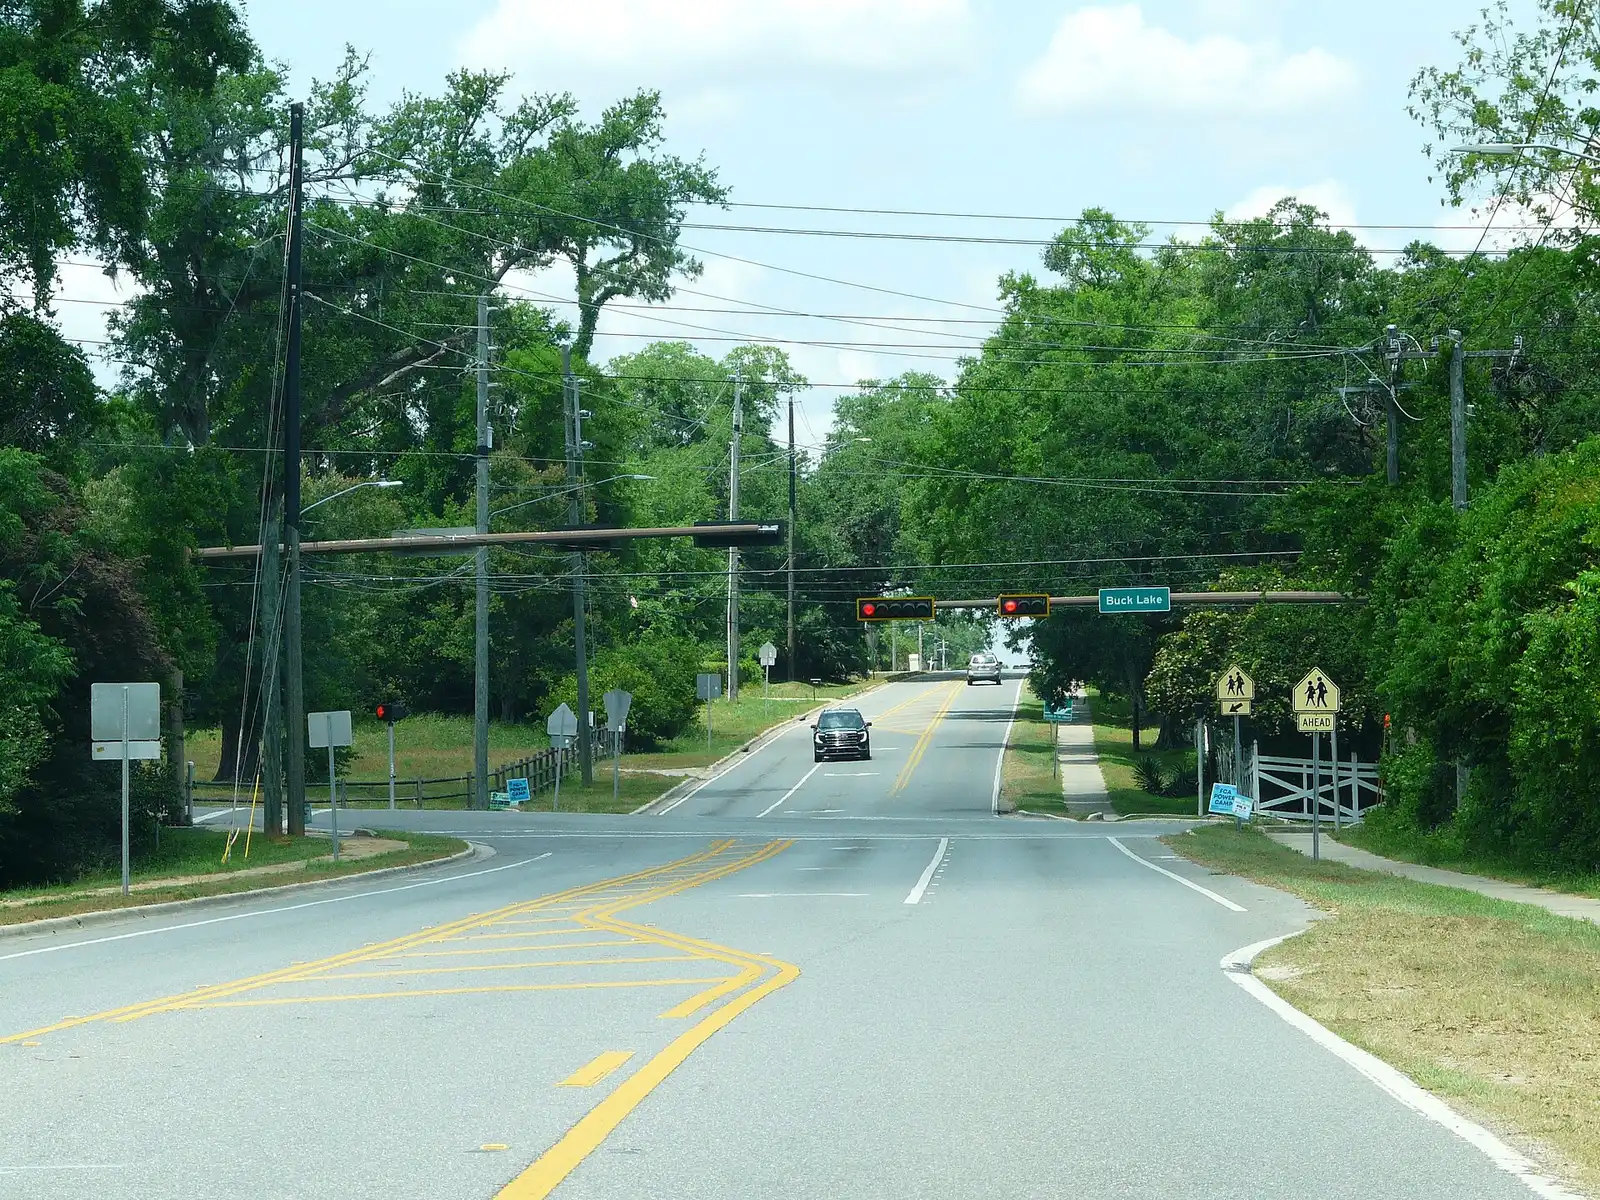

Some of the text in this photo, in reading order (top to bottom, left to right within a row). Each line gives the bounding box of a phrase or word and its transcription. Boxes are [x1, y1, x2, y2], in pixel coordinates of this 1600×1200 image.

[1106, 594, 1163, 605] Buck Lake
[1302, 717, 1331, 727] AHEAD
